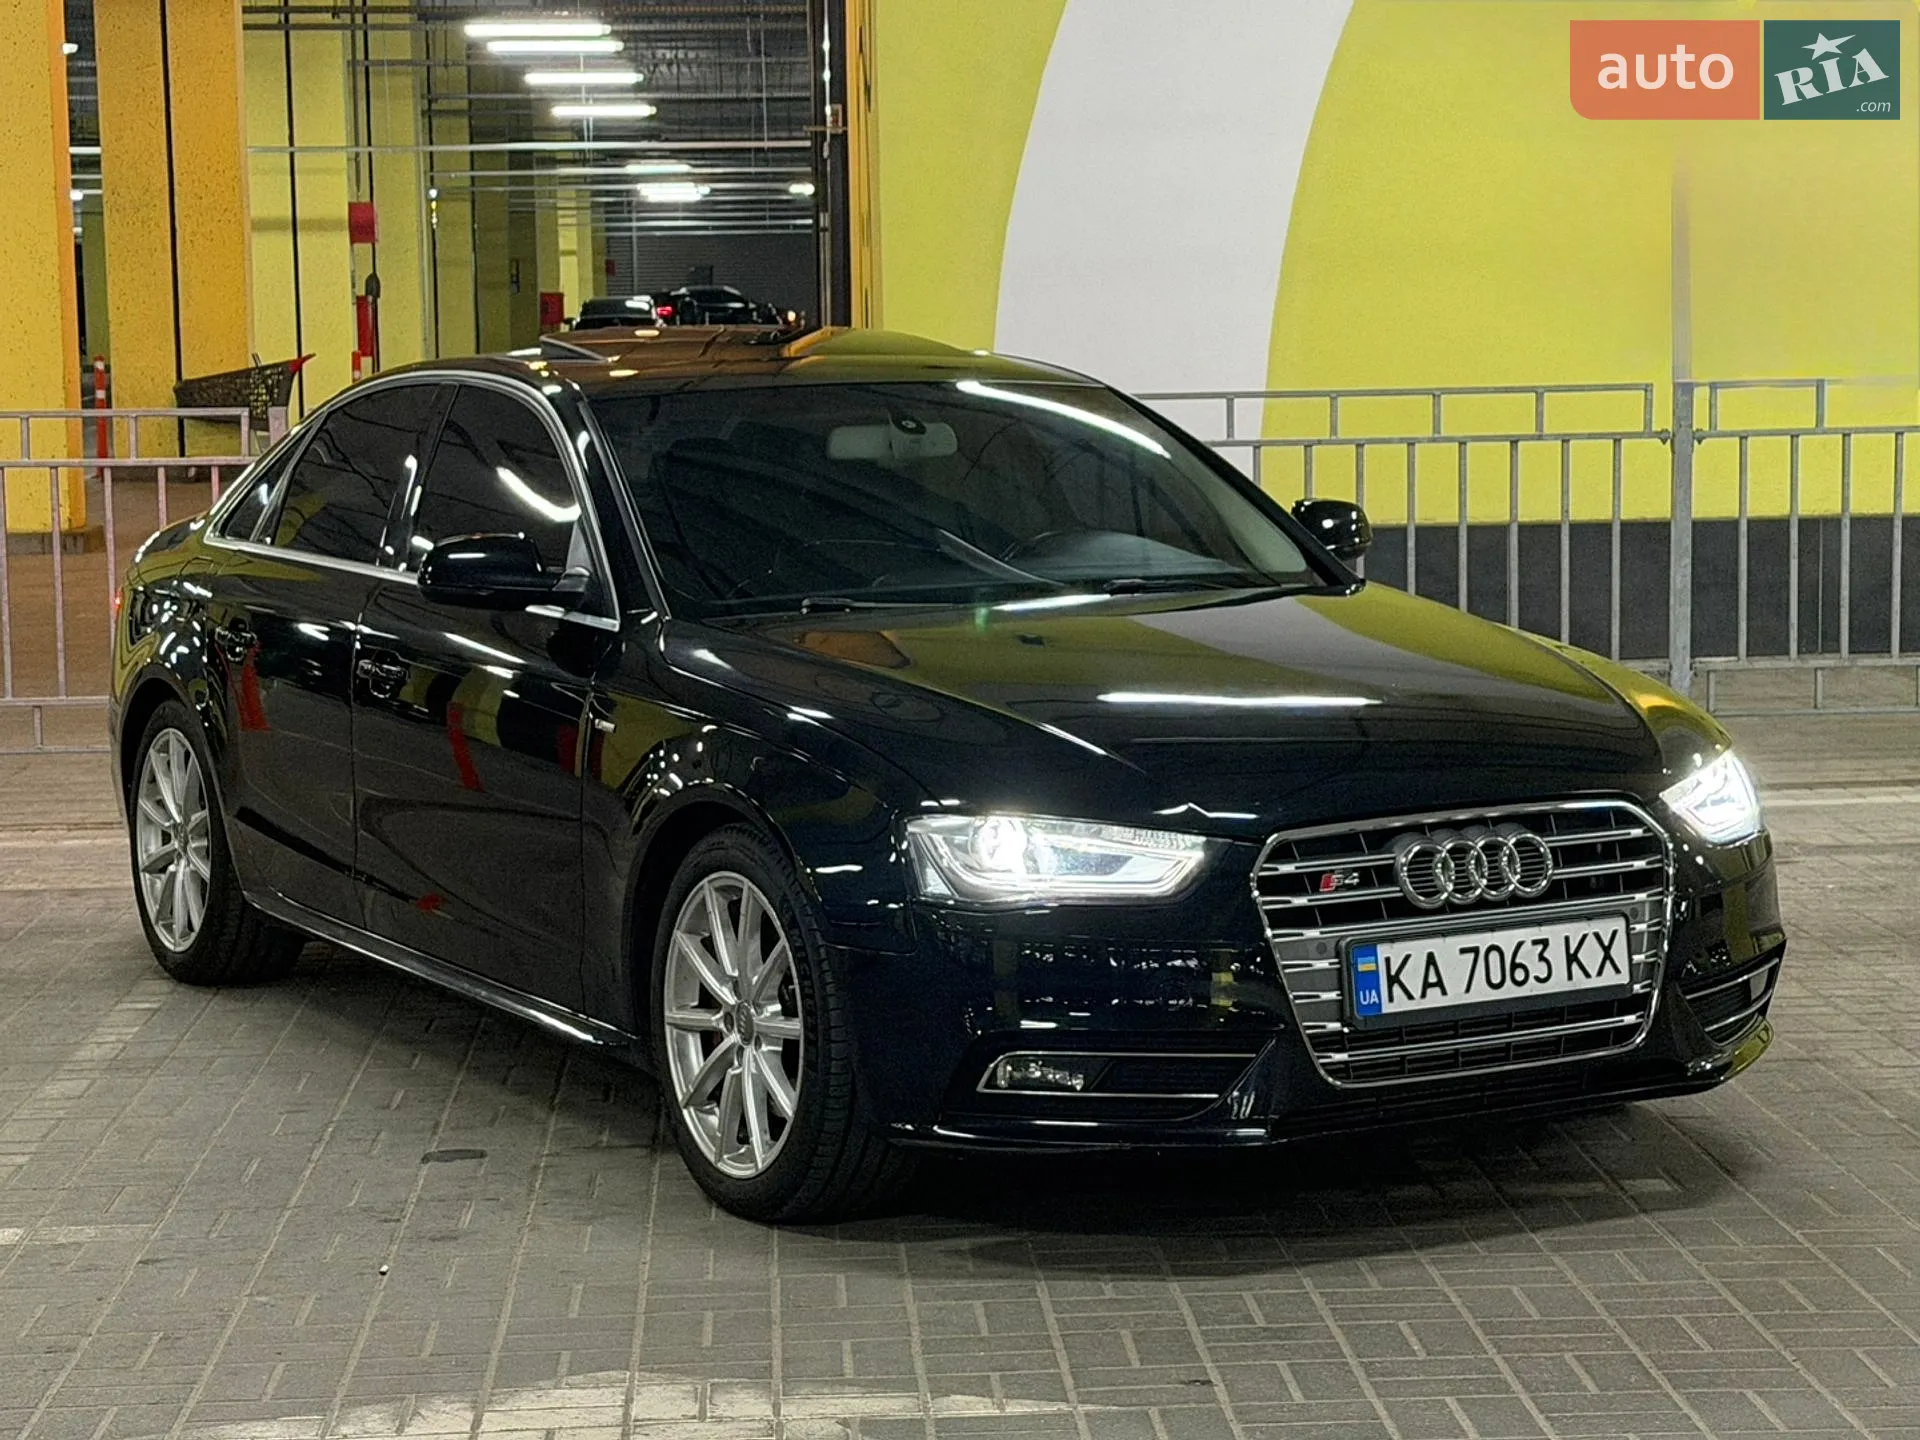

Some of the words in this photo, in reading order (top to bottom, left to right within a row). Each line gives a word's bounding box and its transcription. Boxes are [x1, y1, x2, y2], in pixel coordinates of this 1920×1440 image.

[1384, 951, 1449, 1004] KA
[1458, 937, 1553, 994] 7063
[1563, 928, 1622, 982] KX
[1359, 989, 1380, 1006] UA
